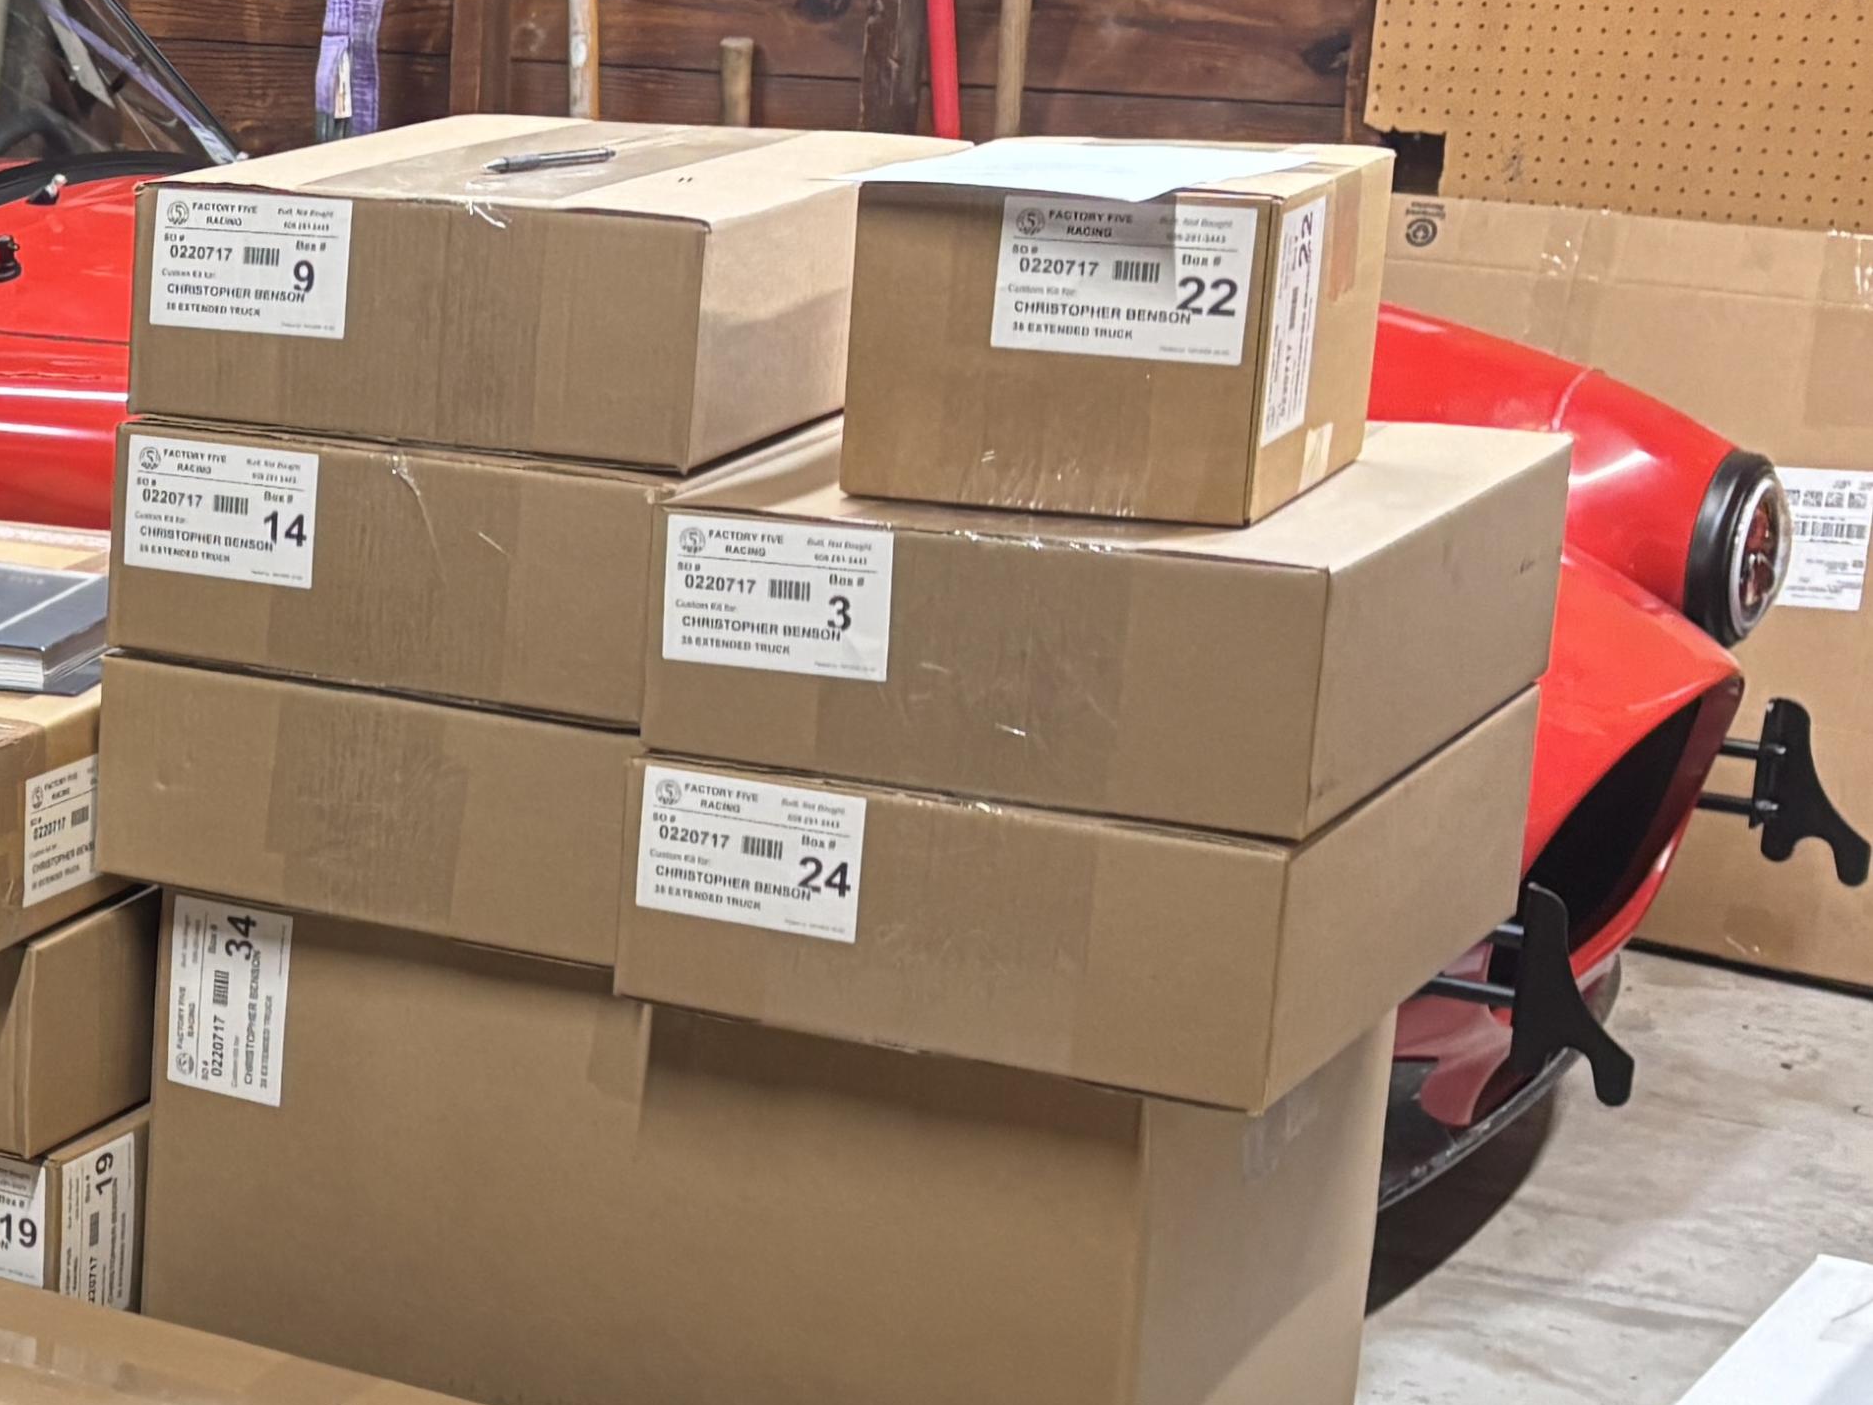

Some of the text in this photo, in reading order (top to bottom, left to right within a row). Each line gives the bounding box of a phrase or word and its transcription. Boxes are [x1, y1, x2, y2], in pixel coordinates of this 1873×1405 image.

[169, 243, 233, 261] 0220717
[1018, 257, 1099, 277] 0220717
[291, 258, 316, 294] 9
[1175, 274, 1240, 317] 22
[1013, 300, 1192, 325] CHRISTOPHER BENSON
[260, 509, 308, 548] 14
[683, 573, 756, 594] 0220717
[824, 593, 853, 632] 3
[658, 824, 730, 849] 0220717
[655, 864, 812, 902] CHRISTOPHER BENSON
[796, 854, 853, 899] 24
[224, 910, 256, 961] 34
[95, 1151, 114, 1196] 19
[0, 1211, 38, 1251] 19
[87, 1256, 98, 1304] 220717
